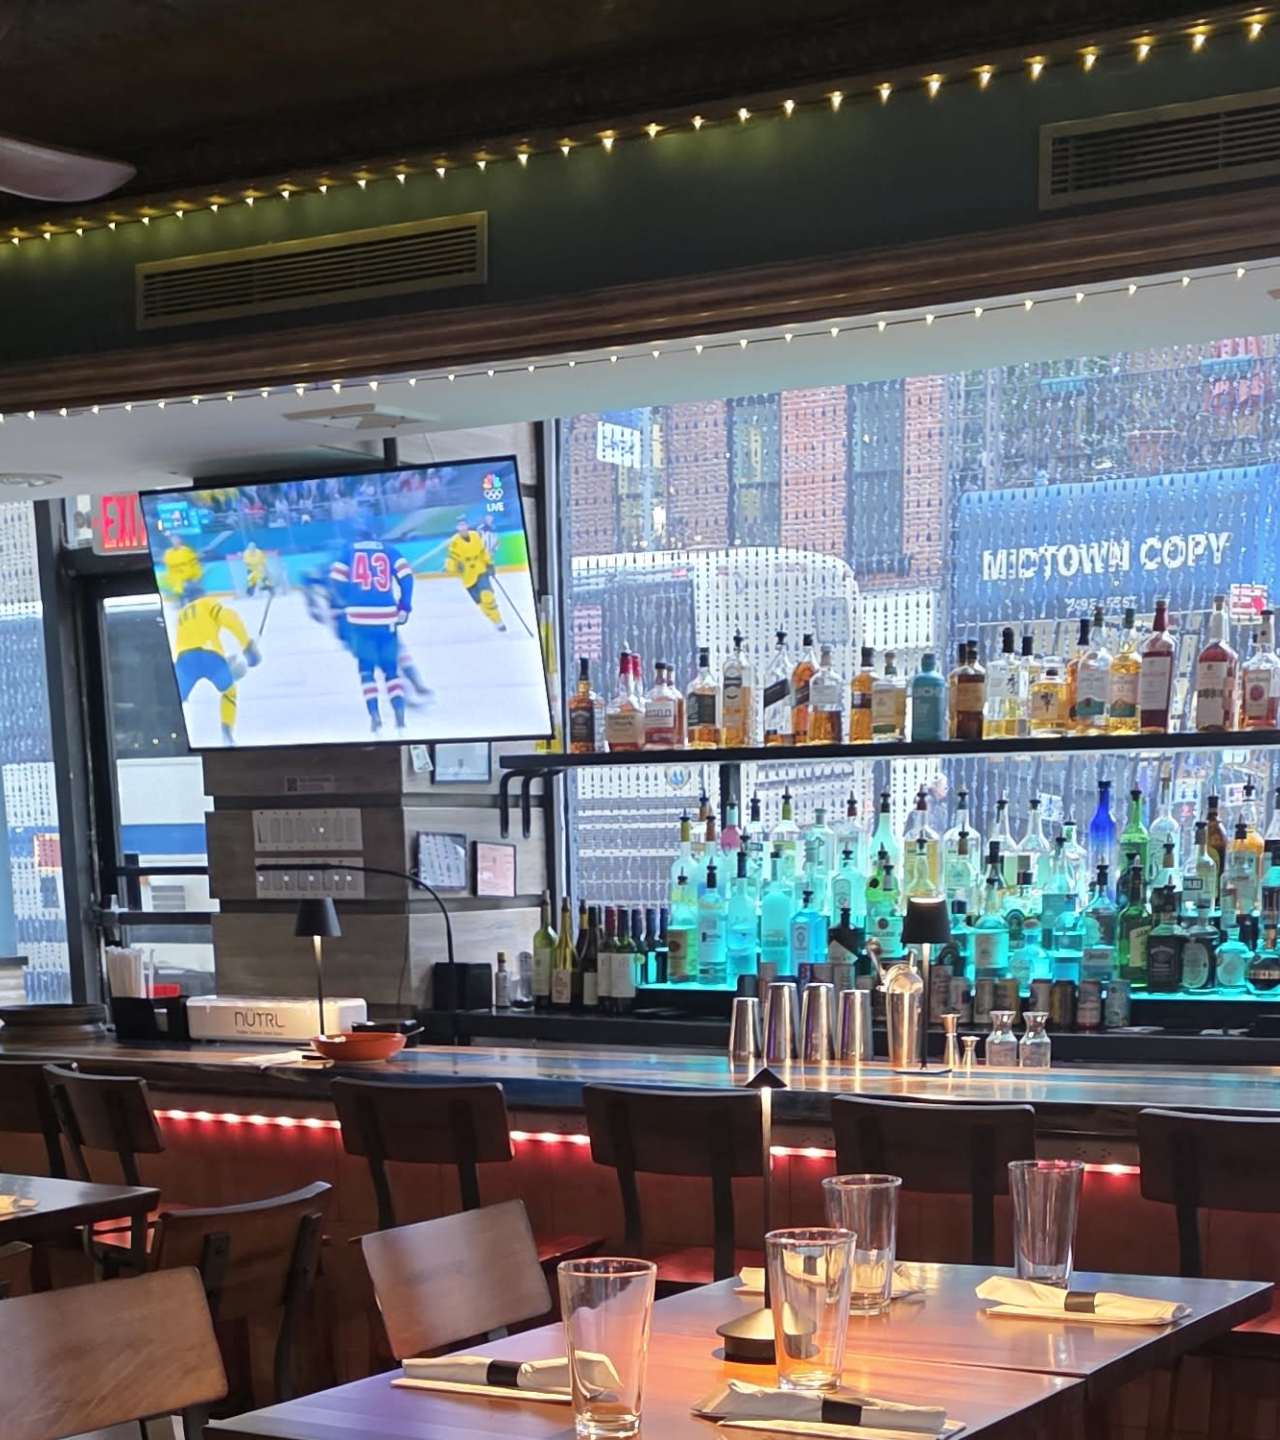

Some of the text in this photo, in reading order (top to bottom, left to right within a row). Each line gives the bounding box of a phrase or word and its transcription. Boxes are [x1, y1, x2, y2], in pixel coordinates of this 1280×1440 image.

[486, 502, 505, 513] LIVE
[351, 551, 391, 592] 43
[981, 531, 1233, 581] MIDTOWN COPY
